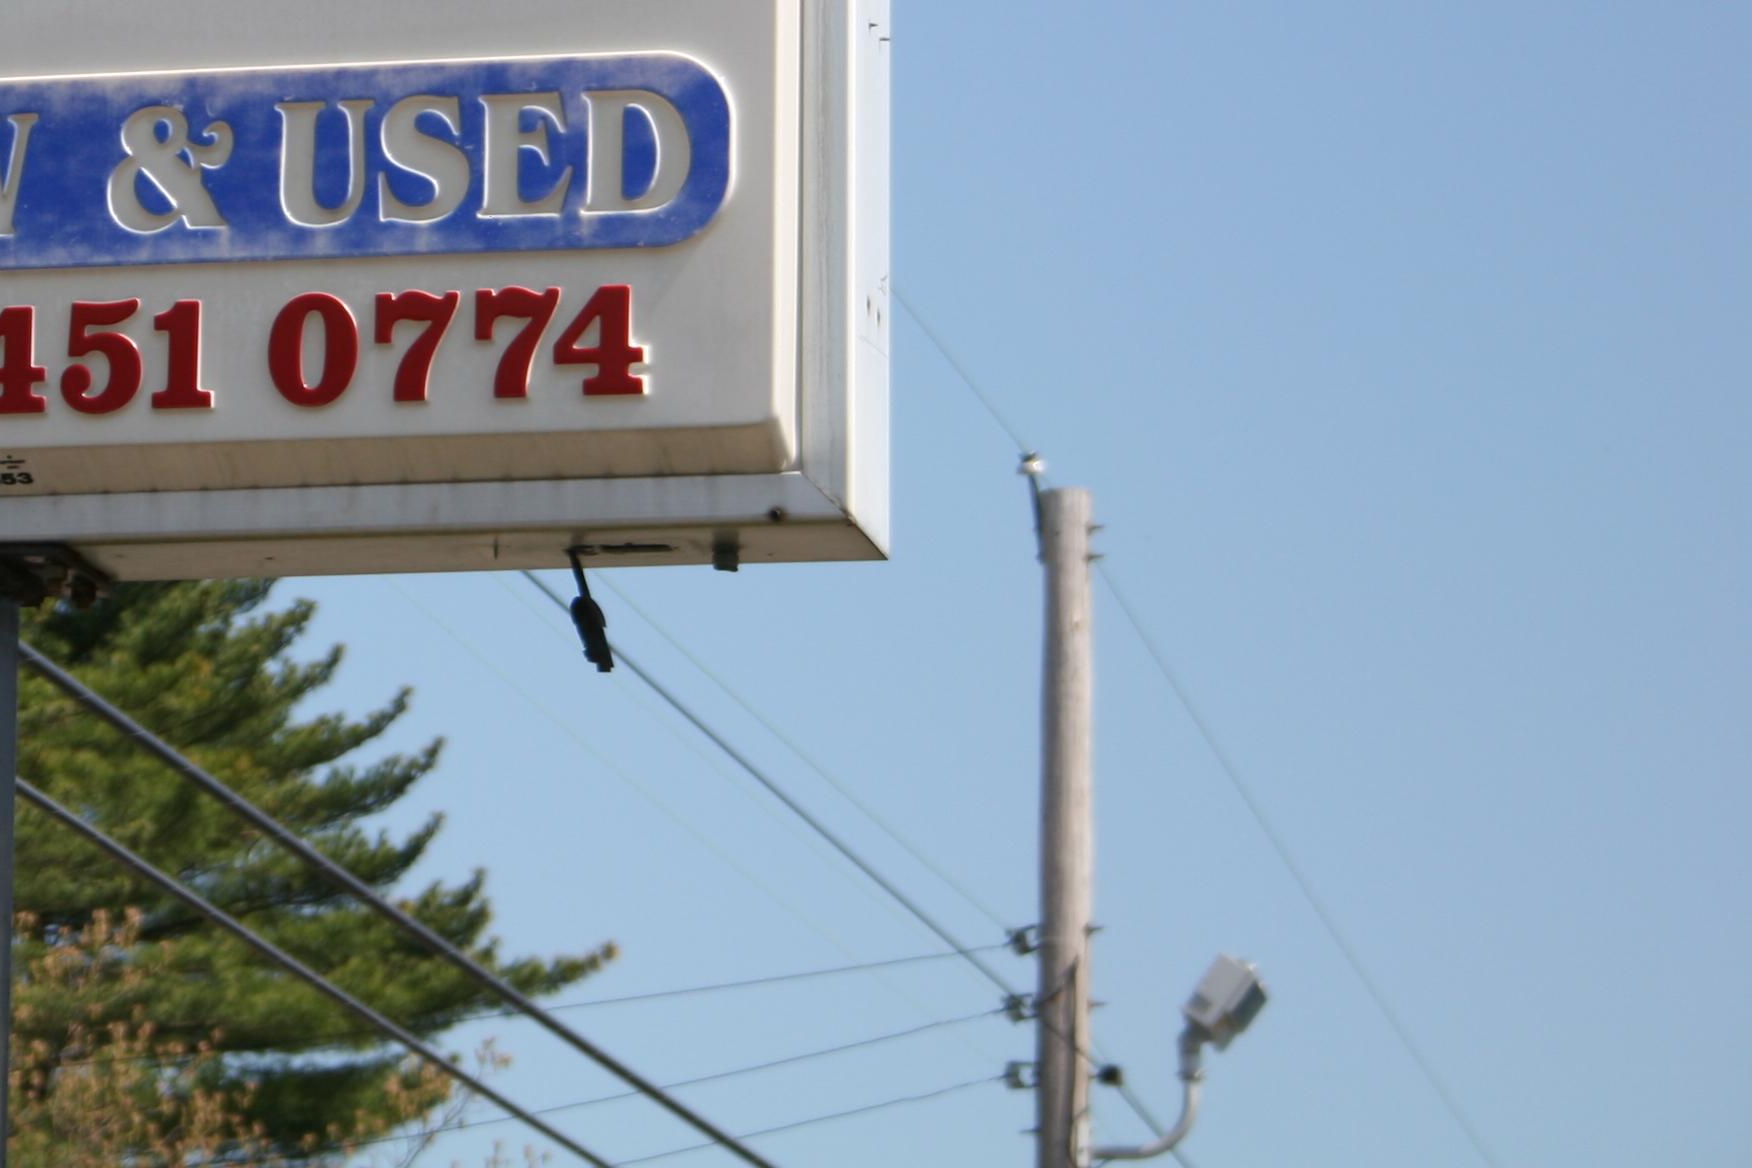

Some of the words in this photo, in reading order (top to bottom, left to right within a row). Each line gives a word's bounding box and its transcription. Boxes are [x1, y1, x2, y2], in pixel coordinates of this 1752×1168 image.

[107, 105, 233, 234] &
[276, 88, 691, 227] USED
[268, 284, 646, 407] 0774
